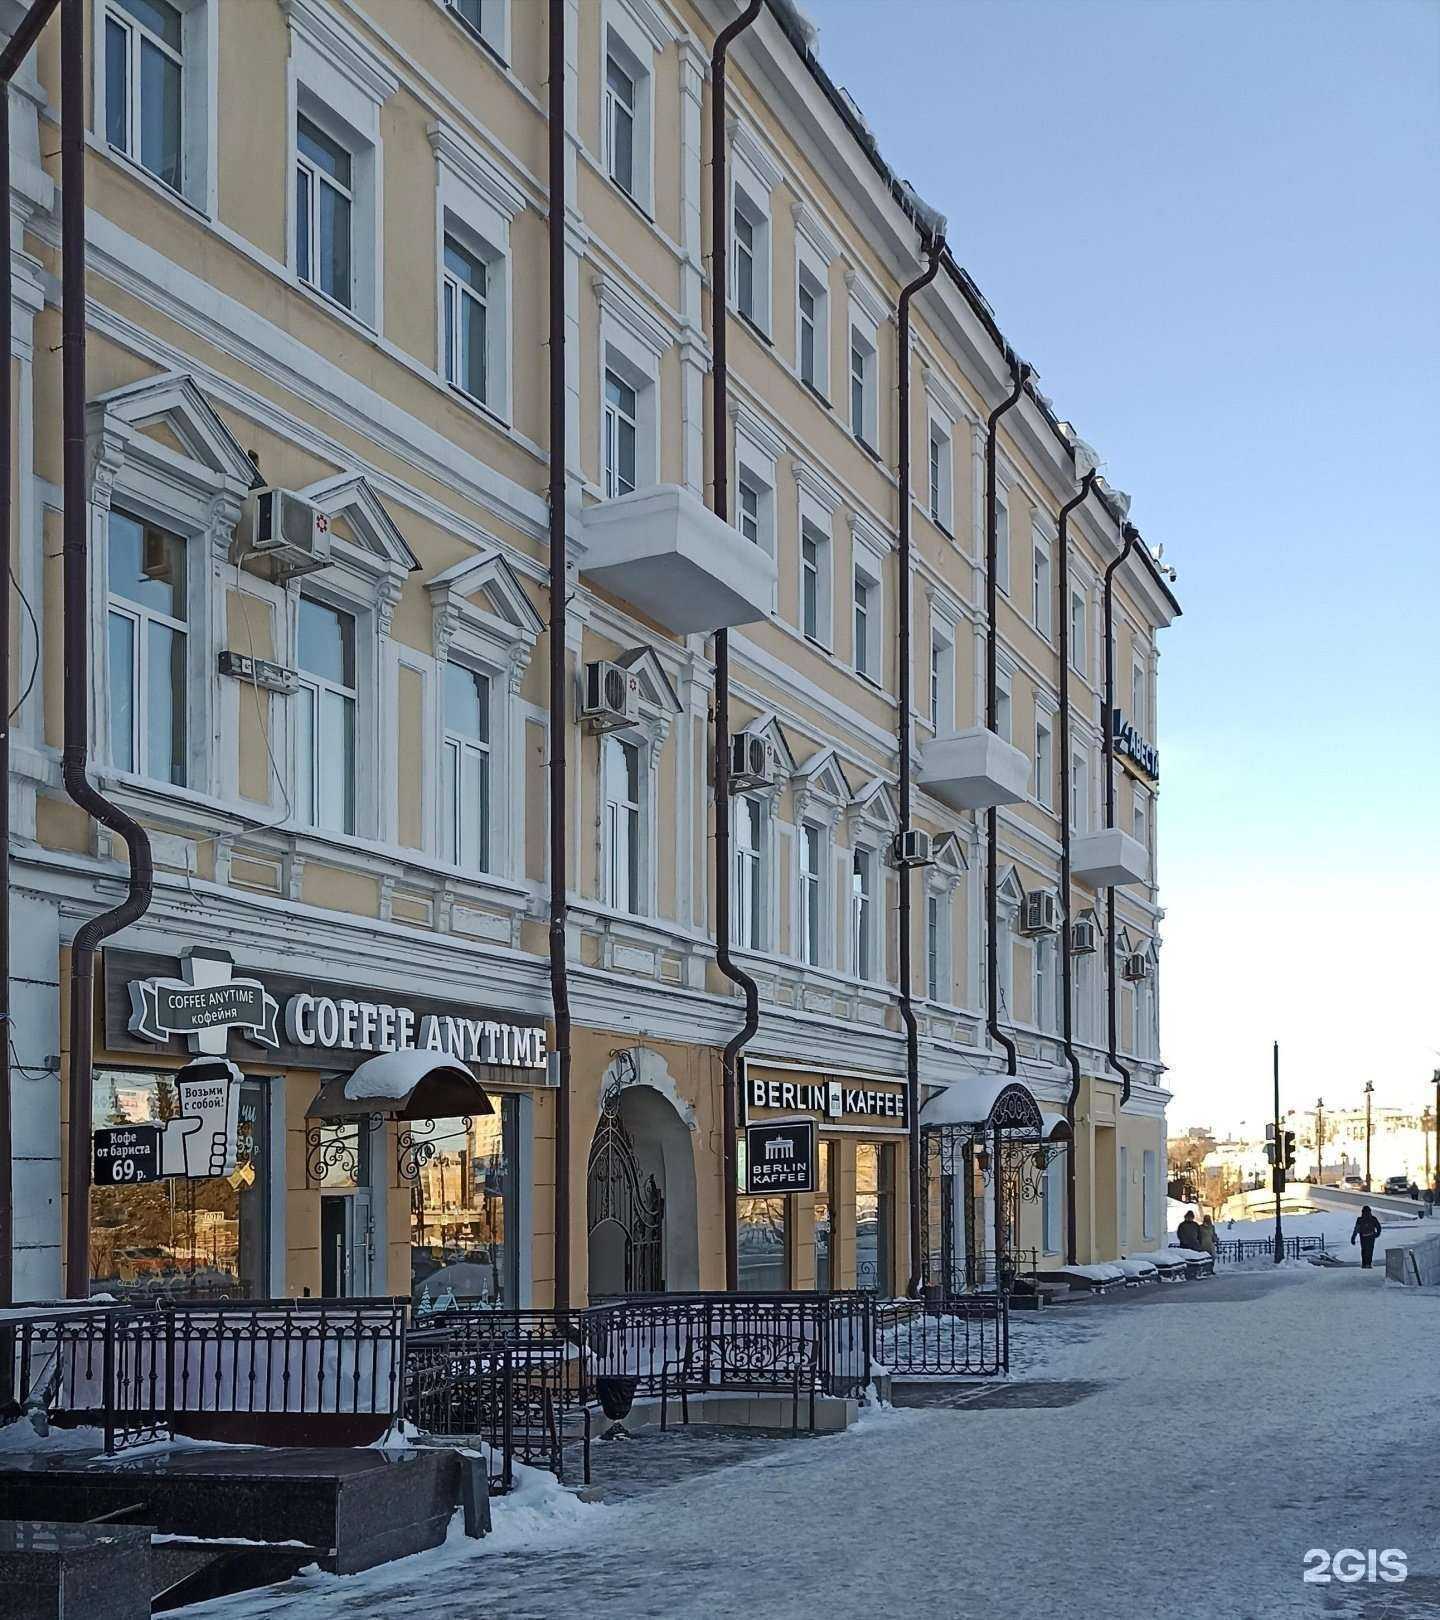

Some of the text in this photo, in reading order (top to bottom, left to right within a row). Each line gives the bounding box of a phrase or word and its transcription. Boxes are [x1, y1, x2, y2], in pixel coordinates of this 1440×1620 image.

[168, 989, 254, 1009] COFFEE ANYTIME
[192, 1007, 237, 1026] кофейня
[287, 993, 547, 1068] COFFEE ANYTIME
[185, 1087, 223, 1098] Возьми
[752, 1079, 905, 1117] BERLIN KAFFEE
[184, 1097, 225, 1111] с собой!
[110, 1131, 137, 1146] Кофе
[97, 1145, 151, 1158] от бариста
[112, 1159, 135, 1181] 69
[753, 1162, 807, 1174] BERLIN
[752, 1172, 806, 1184] KAFFEE
